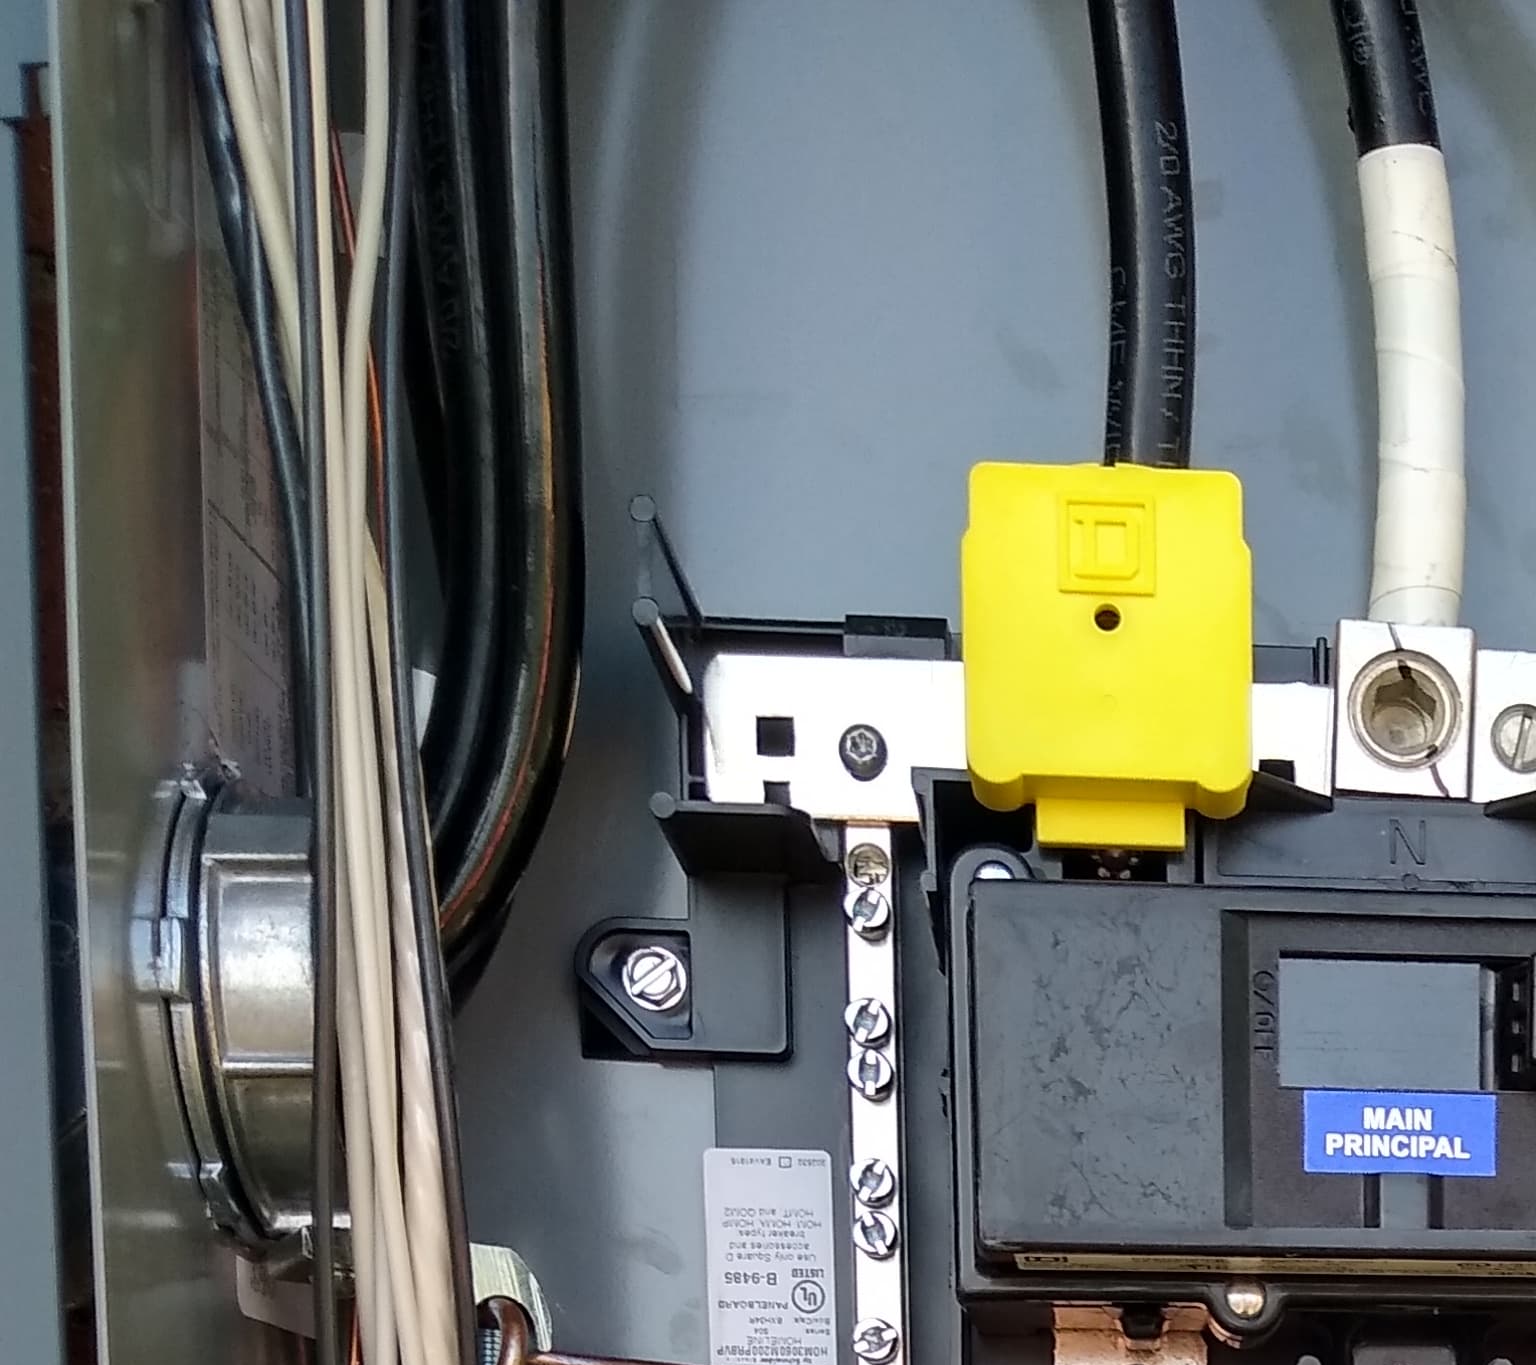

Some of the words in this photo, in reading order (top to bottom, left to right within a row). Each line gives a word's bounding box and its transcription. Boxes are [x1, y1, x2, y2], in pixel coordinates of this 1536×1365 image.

[1160, 186, 1186, 279] AWG
[1389, 819, 1426, 865] N
[1363, 1107, 1433, 1132] MAIN
[1325, 1134, 1470, 1160] PRINCIPAL
[737, 1253, 771, 1262] Square
[724, 1272, 777, 1285] B-9485
[792, 1268, 824, 1278] LISTED
